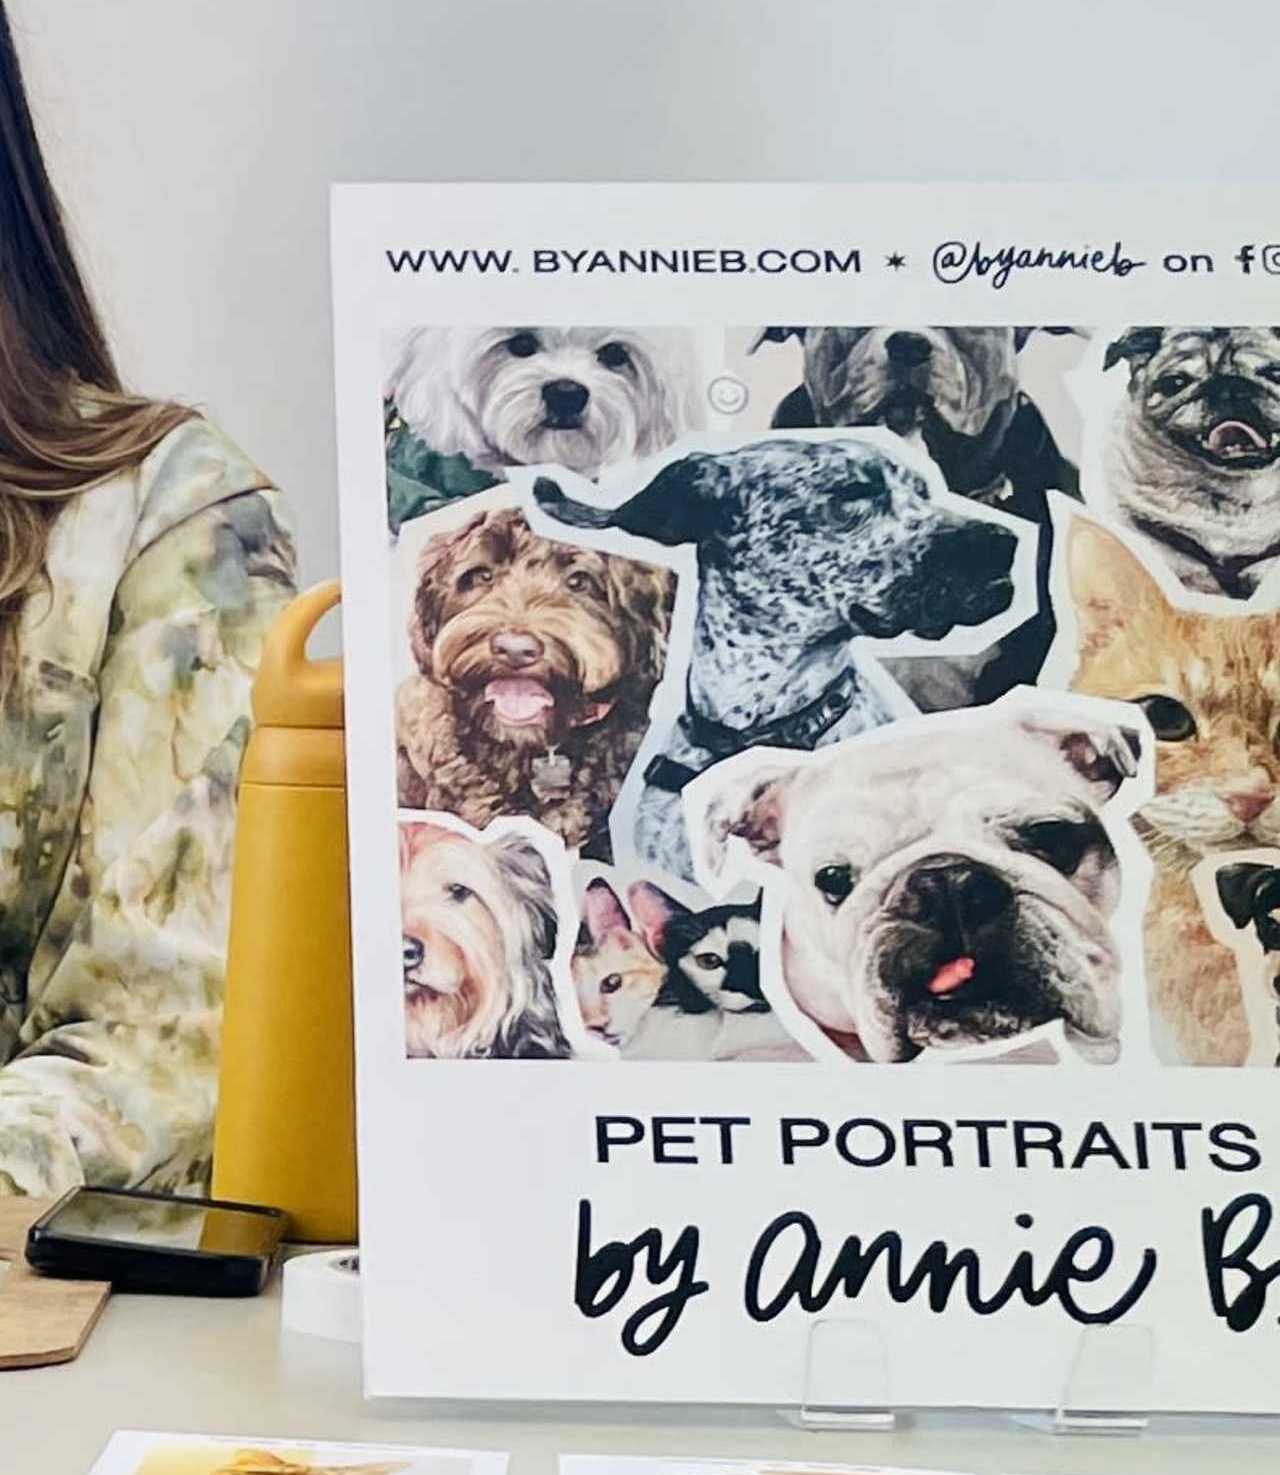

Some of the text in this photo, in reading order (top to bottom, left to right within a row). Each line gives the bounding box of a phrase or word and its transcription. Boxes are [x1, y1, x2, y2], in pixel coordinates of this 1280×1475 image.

[1163, 254, 1214, 273] on
[595, 1115, 1262, 1173] PET PORTRAITS
[574, 1199, 709, 1357] by
